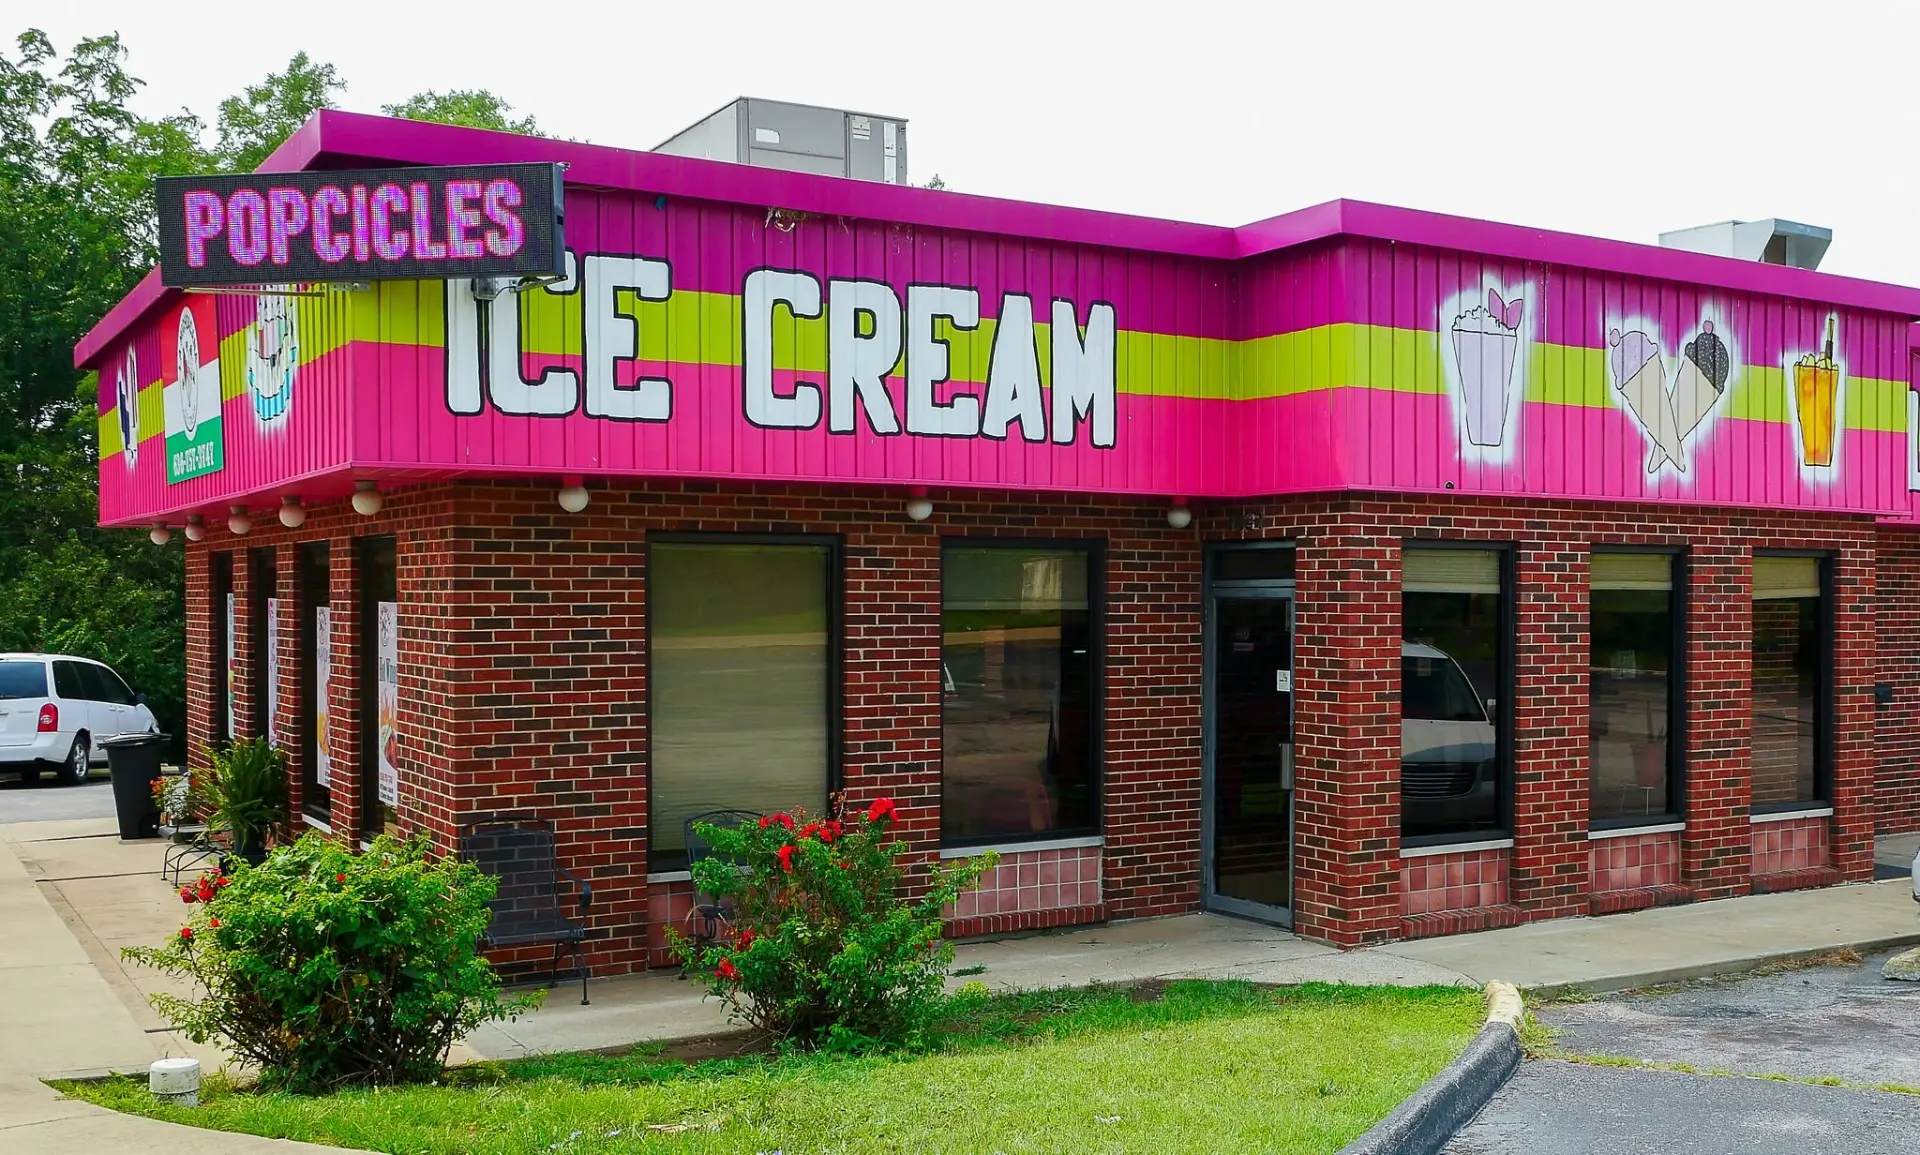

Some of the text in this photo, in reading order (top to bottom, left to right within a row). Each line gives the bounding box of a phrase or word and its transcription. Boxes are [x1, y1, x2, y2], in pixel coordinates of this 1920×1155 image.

[183, 178, 524, 268] POPCICLES
[443, 248, 1117, 449] ICE CREAM
